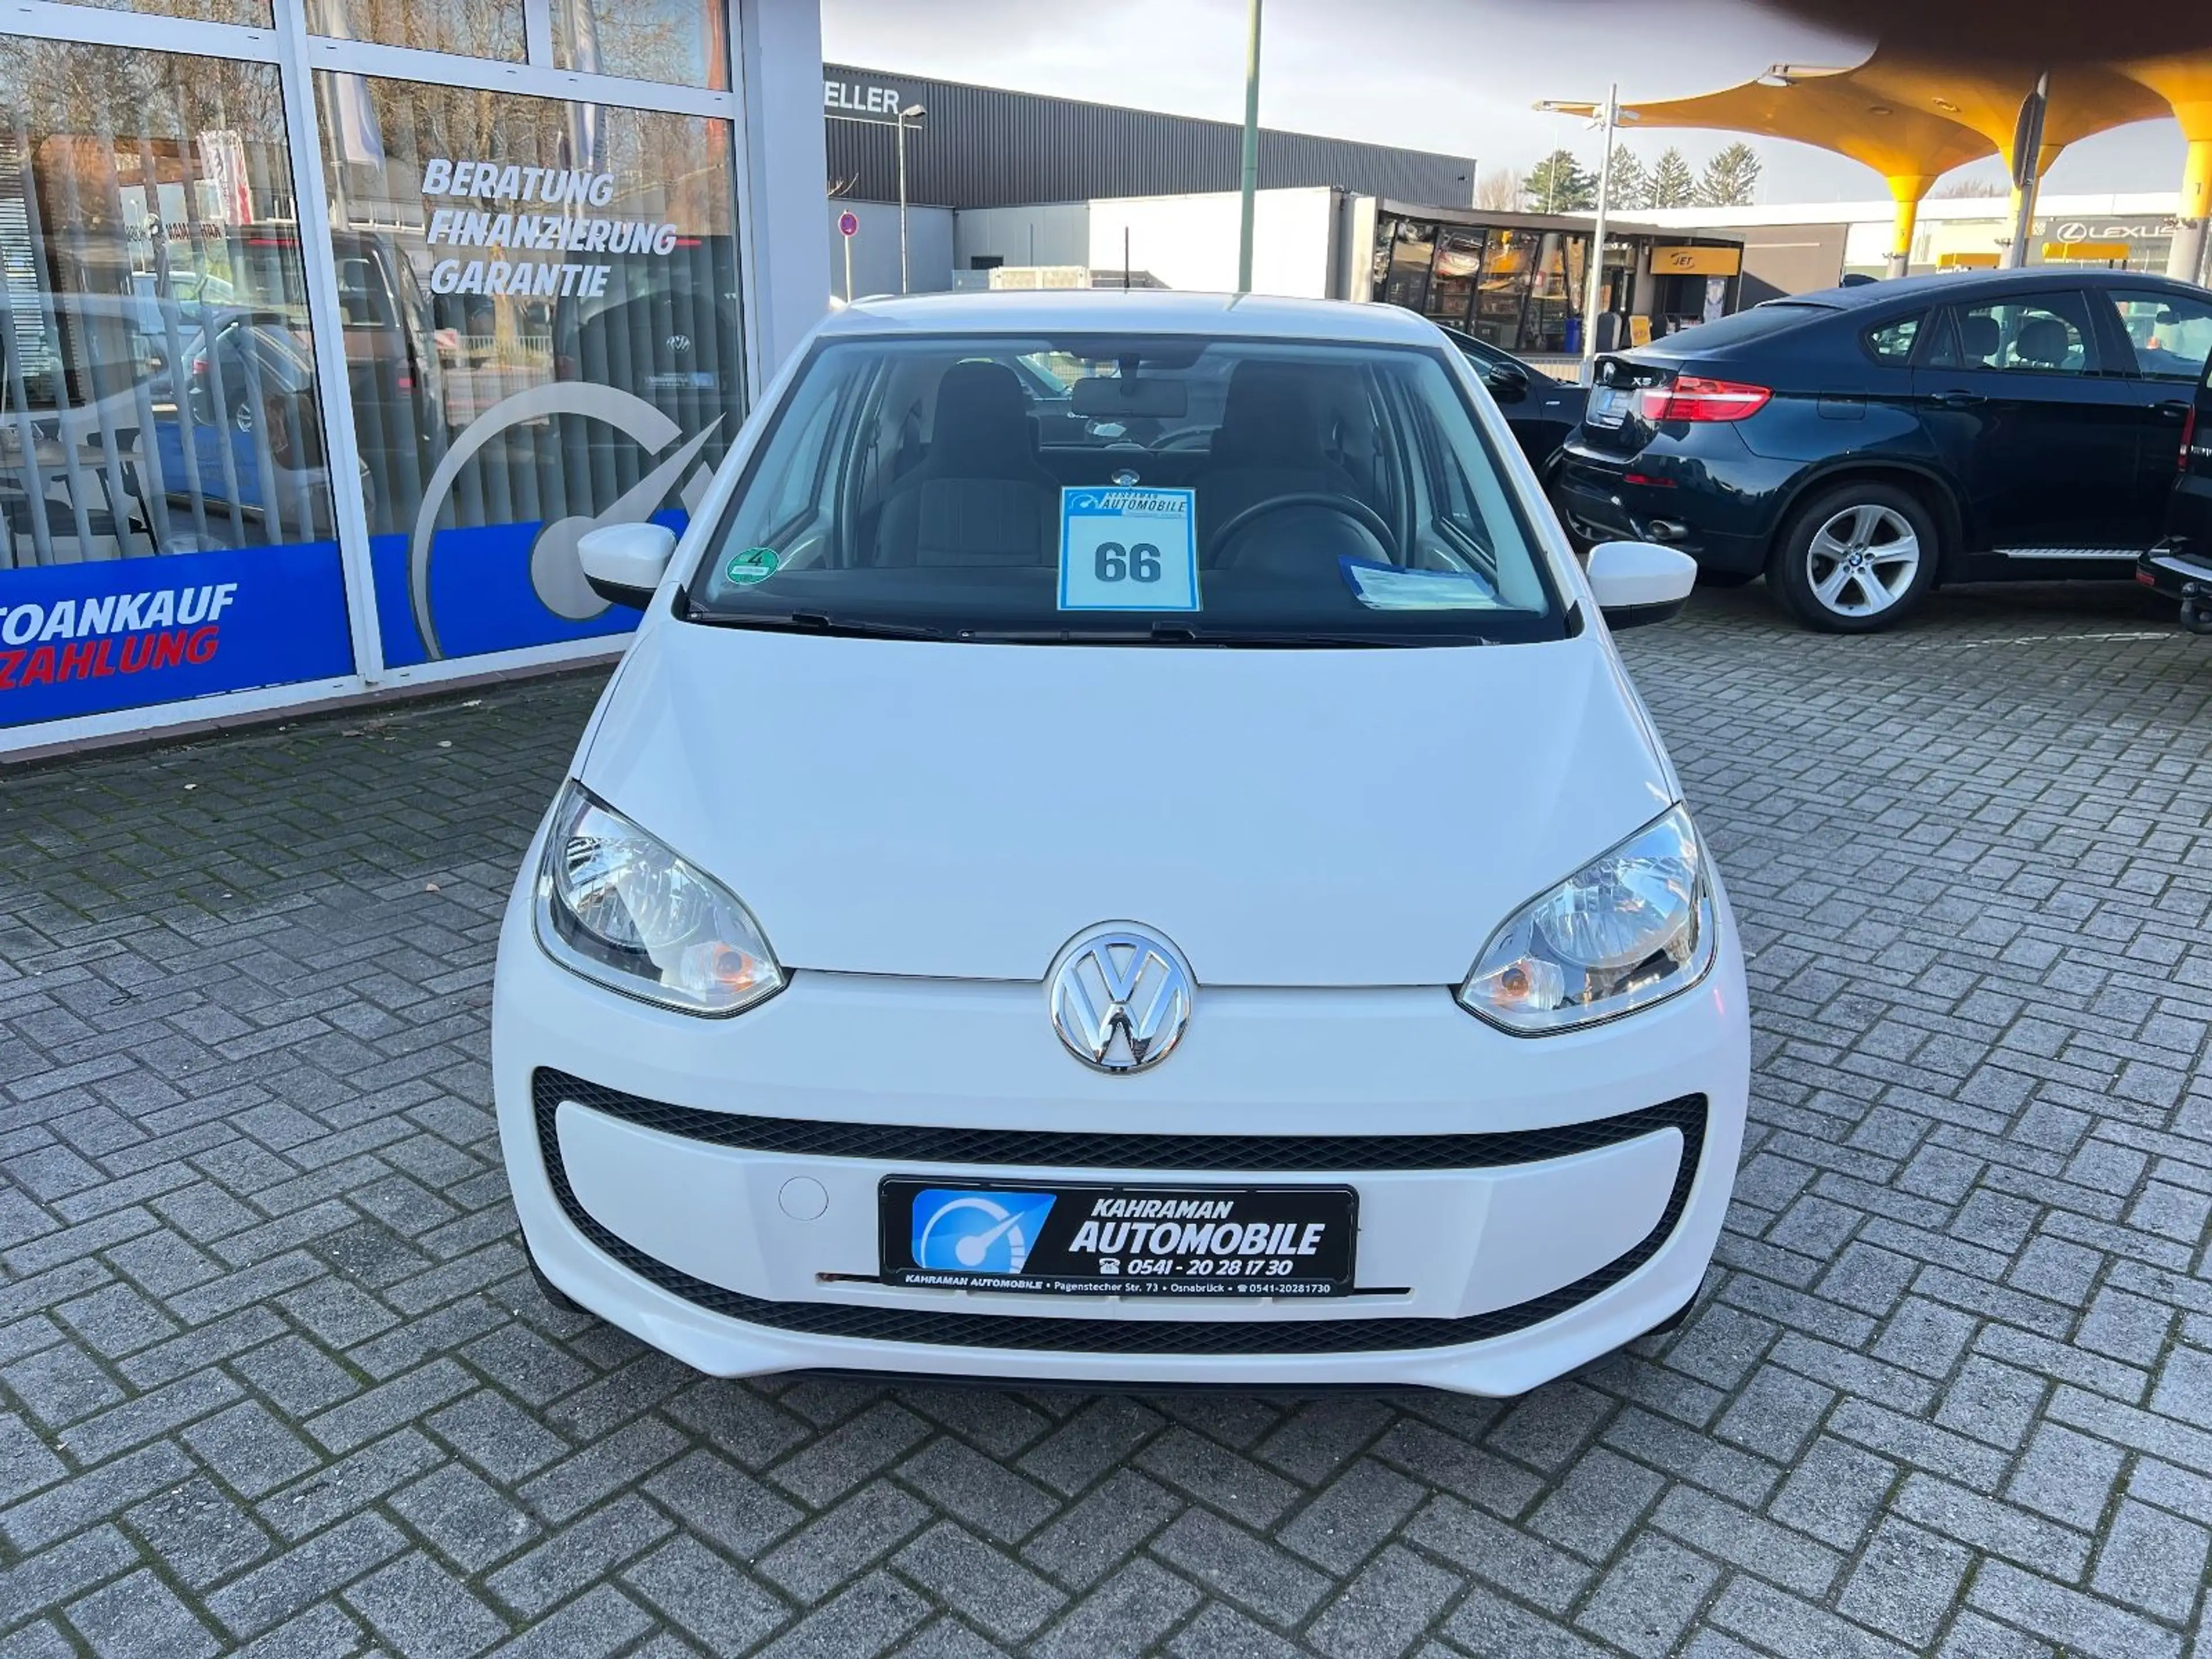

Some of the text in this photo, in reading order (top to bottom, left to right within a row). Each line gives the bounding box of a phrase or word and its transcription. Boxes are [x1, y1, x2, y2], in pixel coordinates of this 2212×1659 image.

[823, 80, 900, 115] ELLER
[422, 158, 615, 207] BERATUNG
[427, 209, 677, 256] FINANZIERUNG
[2089, 225, 2176, 238] LEXUS
[431, 258, 611, 297] GARANTIE
[1673, 257, 1693, 266] JET
[1101, 499, 1187, 512] AUTOMOBILE
[747, 549, 764, 567] 4
[1094, 541, 1161, 583] 66
[0, 583, 237, 645] OANKAUF
[0, 625, 219, 690] ZAHLUNG
[1091, 1198, 1234, 1219] KAHRAMAN
[1069, 1221, 1325, 1255] AUTOMOBILE
[905, 1274, 1331, 1293] KAHRAMAN AUTOMOBILE Pagenstecher Str. 73 Osnabrück 0541-20281730
[1127, 1259, 1173, 1275] 0541
[1185, 1260, 1213, 1276] 20
[1215, 1260, 1242, 1276] 28
[1245, 1260, 1266, 1276] 17
[1264, 1260, 1294, 1276] 30
